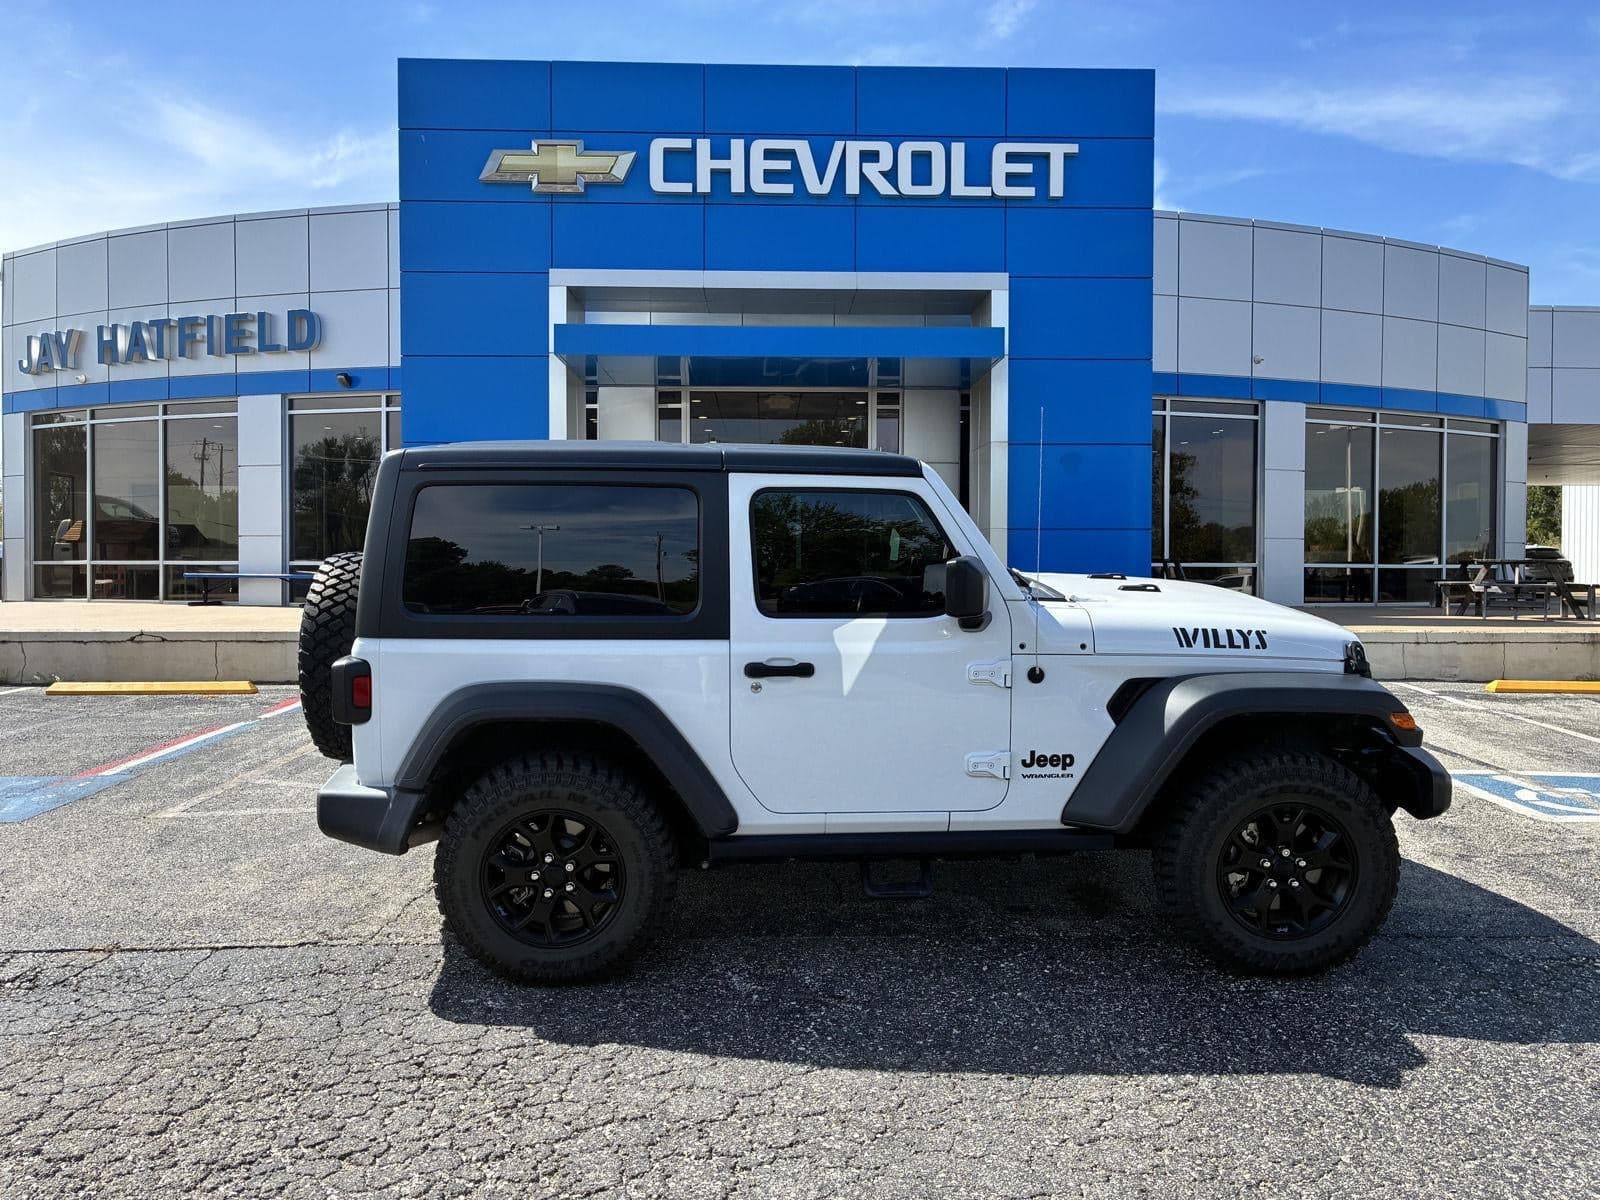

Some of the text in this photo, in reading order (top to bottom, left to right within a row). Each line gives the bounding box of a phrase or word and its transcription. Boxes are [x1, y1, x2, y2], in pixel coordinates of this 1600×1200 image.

[649, 138, 1080, 197] CHEVROLET
[18, 309, 322, 375] JAY HATFIELD
[1172, 627, 1268, 650] WILLYS
[1021, 750, 1075, 770] Jeep
